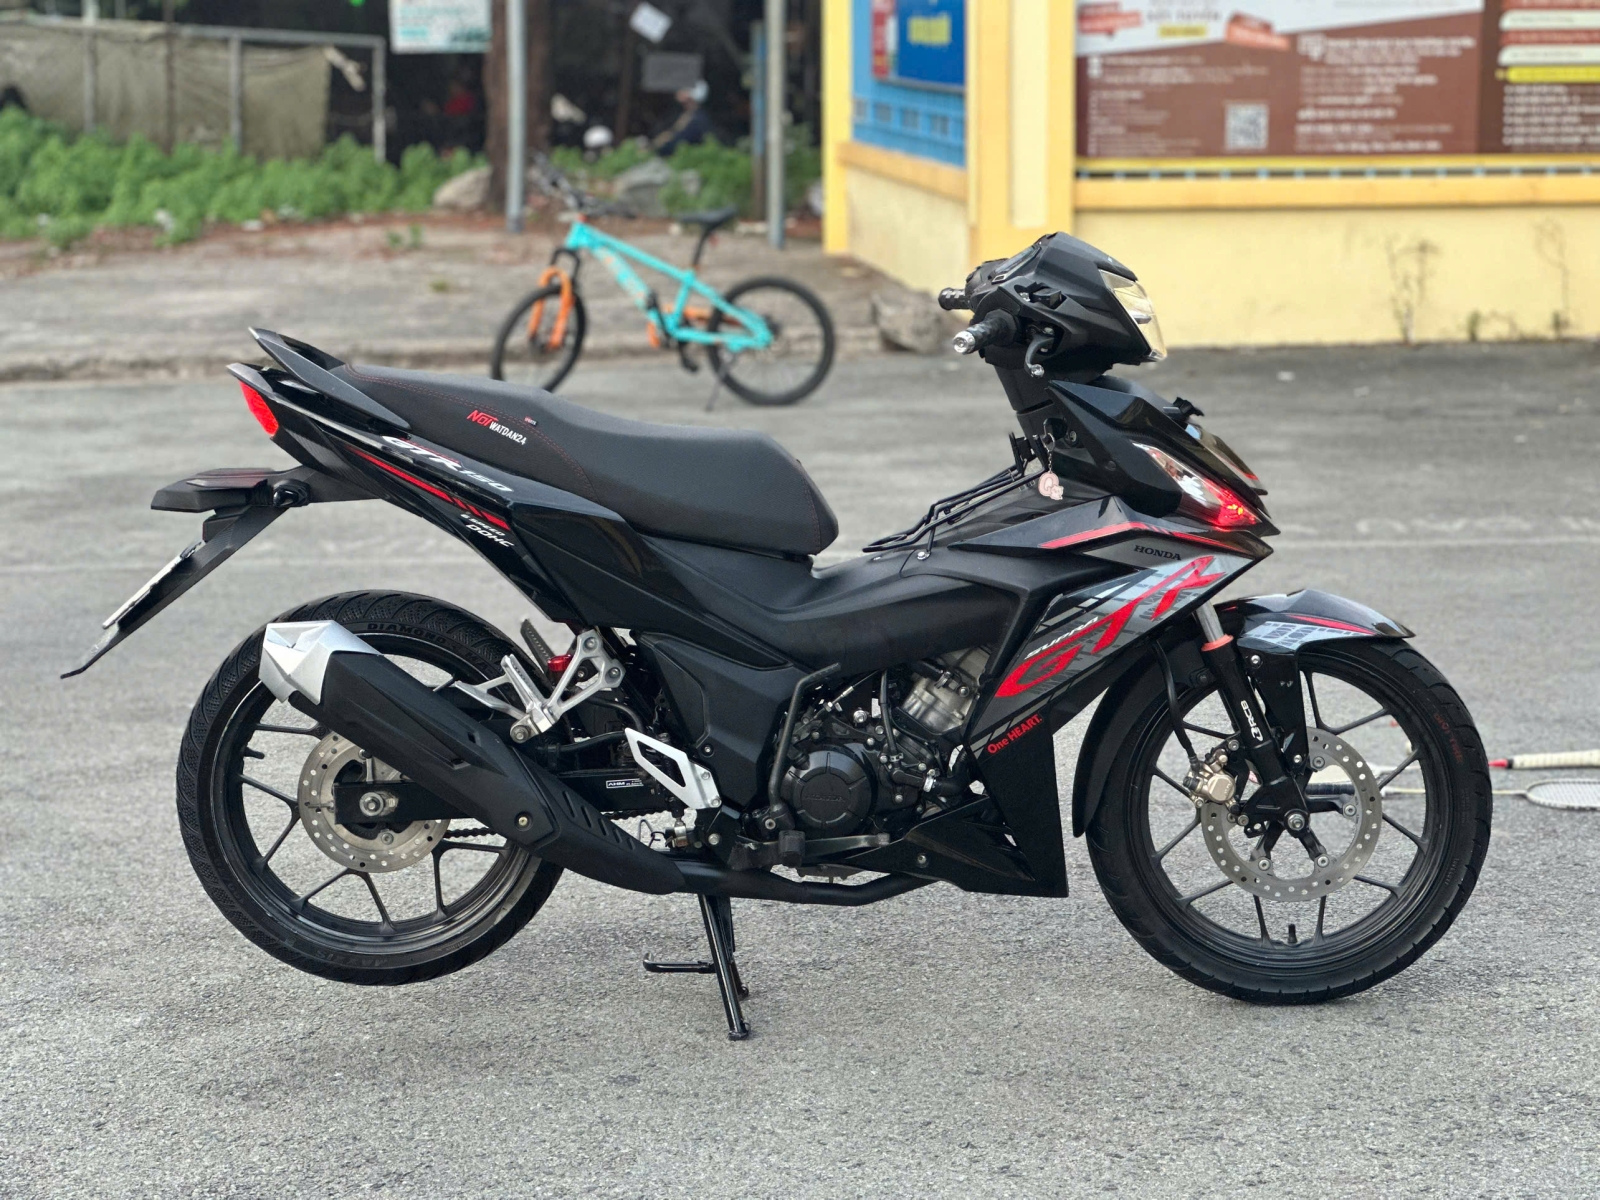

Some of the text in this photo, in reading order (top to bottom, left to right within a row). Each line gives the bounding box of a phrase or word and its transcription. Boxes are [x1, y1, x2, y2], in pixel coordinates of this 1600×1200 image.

[466, 524, 515, 547] DOHC
[1133, 544, 1183, 562] HONDA
[994, 555, 1227, 698] GTR
[1024, 616, 1099, 660] SUPRA
[987, 738, 1010, 754] One
